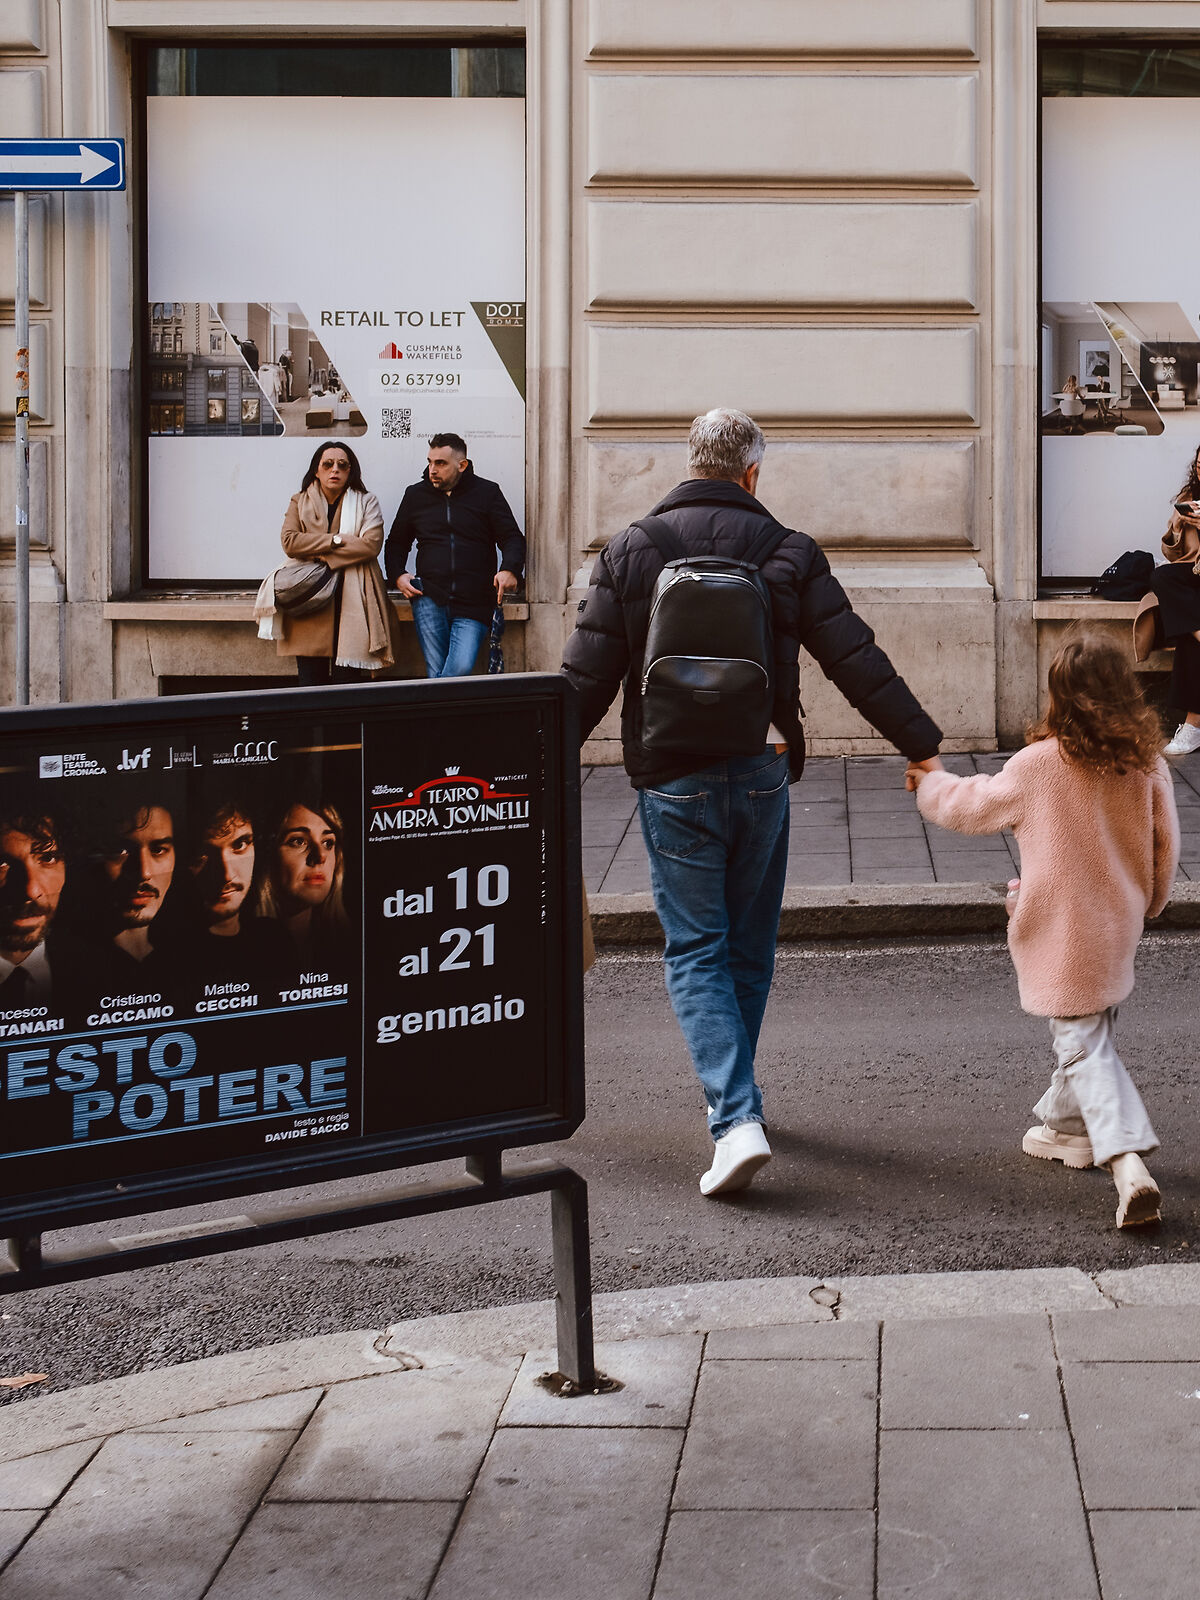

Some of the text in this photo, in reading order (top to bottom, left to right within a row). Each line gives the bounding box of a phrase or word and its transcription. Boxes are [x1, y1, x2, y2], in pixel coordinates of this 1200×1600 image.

[320, 310, 466, 327] RETAIL TO LET
[486, 303, 523, 317] DOT
[406, 344, 453, 352] CUSHMAN
[406, 352, 463, 360] WAKEFIELD
[380, 373, 461, 386] 02 637991
[63, 753, 87, 762] ENTE
[63, 760, 98, 769] TEATRO
[63, 767, 107, 777] CRONACA
[427, 786, 480, 805] TEATRO
[369, 800, 530, 832] AMBRA JOVINELLI
[383, 885, 434, 918] dal
[447, 863, 510, 910] 10
[398, 923, 495, 977] al 21
[300, 971, 329, 985] Nina
[204, 980, 250, 997] Matteo
[279, 983, 348, 1003] TORRESI
[100, 991, 162, 1009] Cristiano
[195, 994, 258, 1013] CECCHI
[86, 1005, 174, 1027] CACCAMO
[376, 994, 525, 1044] gennaio
[0, 1031, 198, 1101] ESTO
[72, 1056, 348, 1140] POTERE
[293, 1111, 350, 1128] testo e regia
[264, 1122, 350, 1143] DAVIDE SACCO
